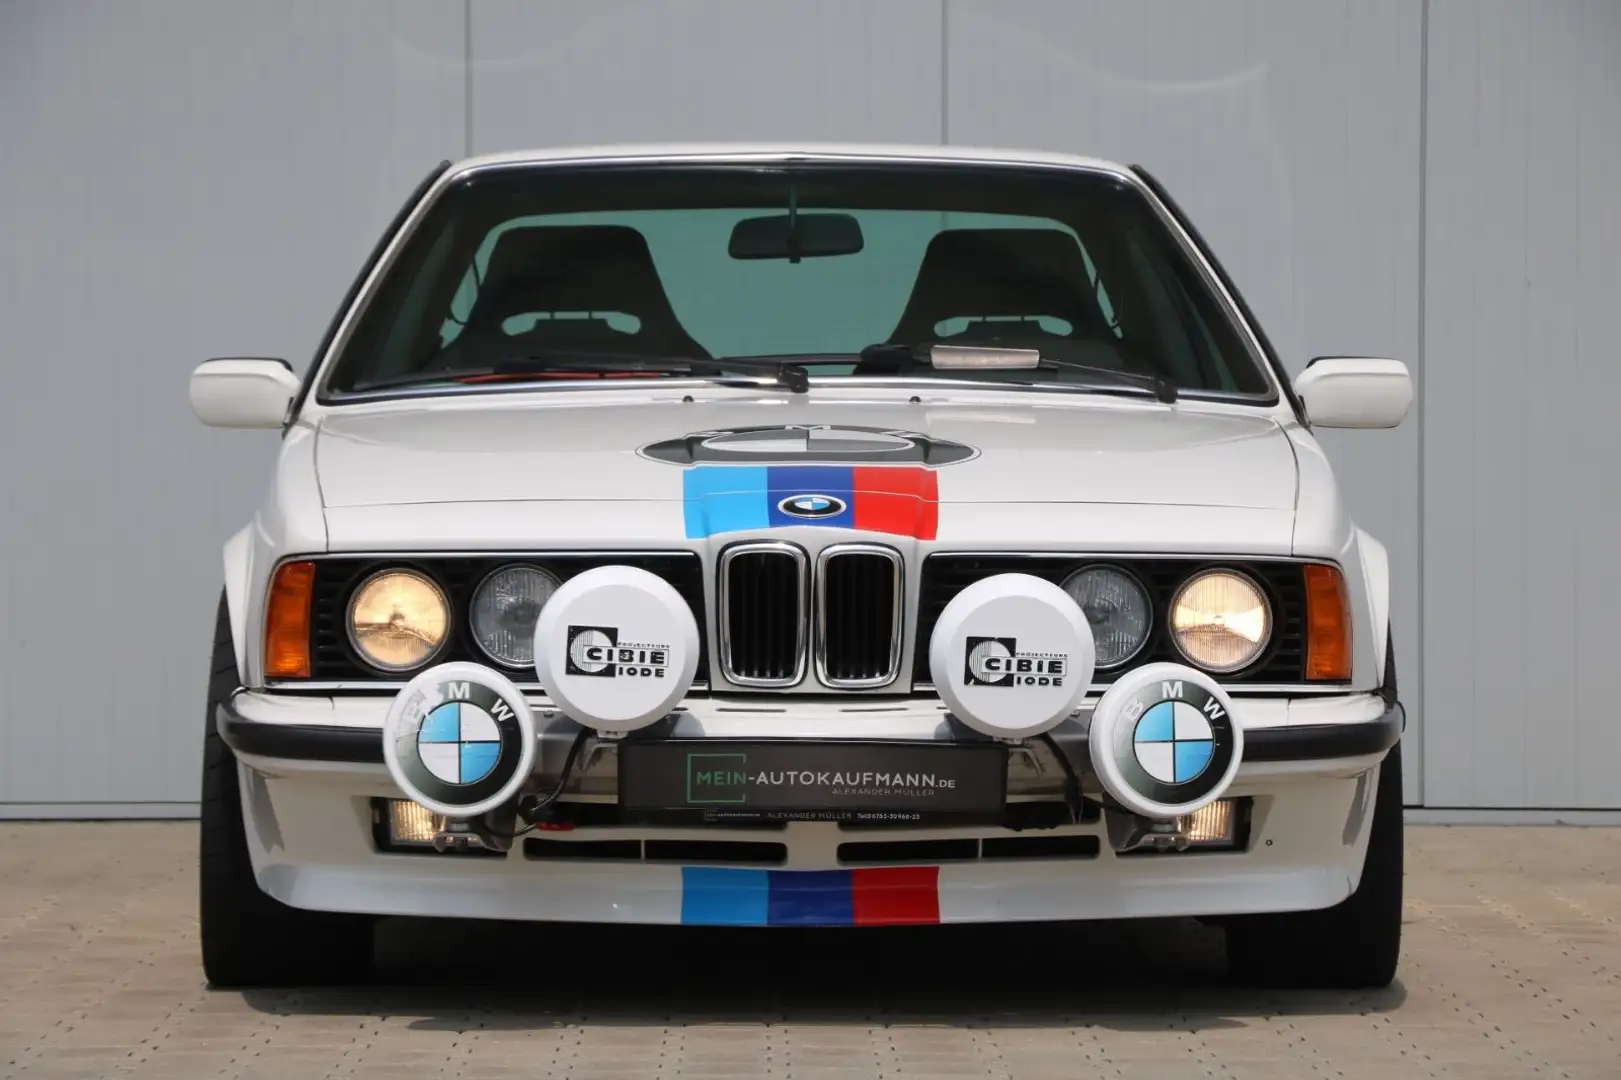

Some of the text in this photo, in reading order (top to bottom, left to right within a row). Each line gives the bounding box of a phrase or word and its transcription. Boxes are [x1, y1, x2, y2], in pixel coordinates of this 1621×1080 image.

[586, 647, 665, 665] CIBIE
[618, 666, 665, 678] IODE
[984, 657, 1063, 674] CIBIE
[1016, 676, 1063, 687] IODE
[1123, 681, 1225, 721] BMW
[697, 771, 956, 788] MEIN-AUTOKAUFMANN.DE
[832, 787, 891, 796] ALEXANDER
[767, 811, 816, 819] ALEXANDER
